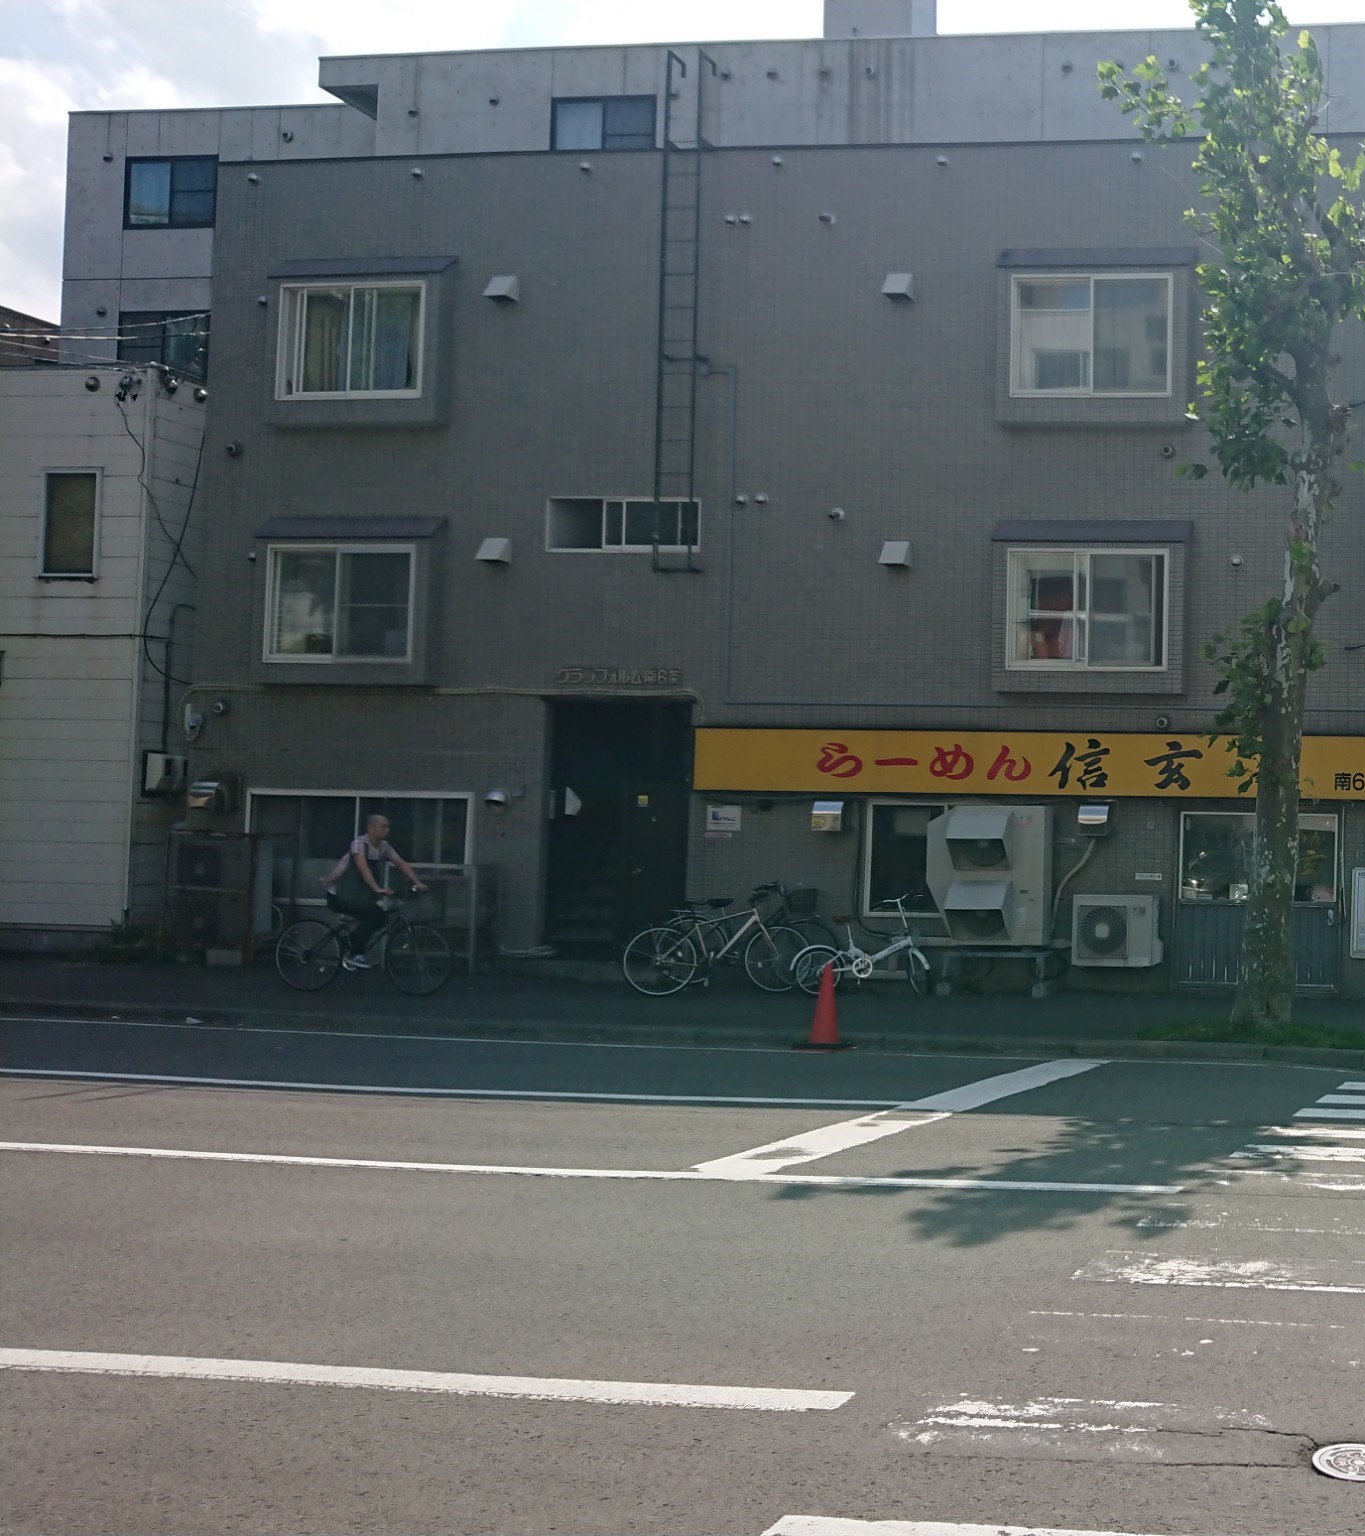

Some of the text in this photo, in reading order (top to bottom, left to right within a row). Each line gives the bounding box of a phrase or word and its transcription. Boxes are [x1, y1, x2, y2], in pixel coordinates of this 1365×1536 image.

[816, 738, 1203, 791] らーめん 信玄
